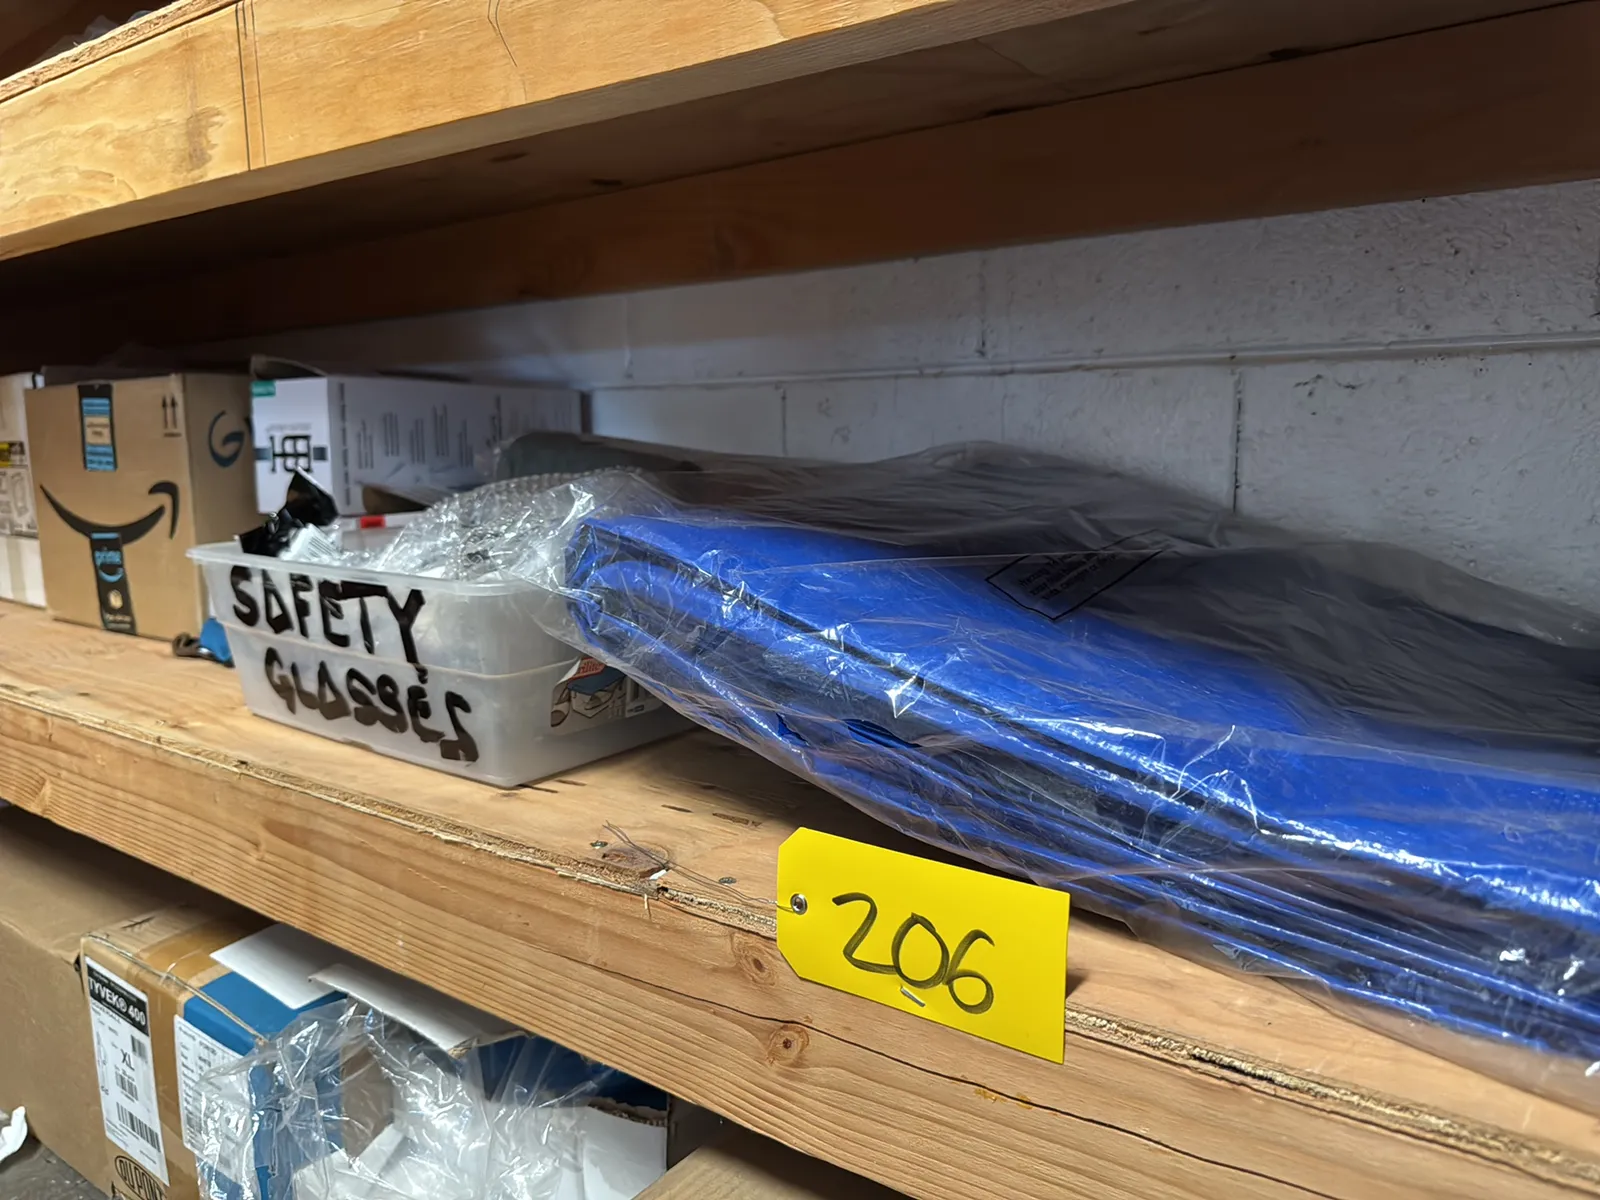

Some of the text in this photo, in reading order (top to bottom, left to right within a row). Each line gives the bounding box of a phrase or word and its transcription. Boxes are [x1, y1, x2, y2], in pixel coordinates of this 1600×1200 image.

[229, 565, 425, 667] SAFETY
[264, 646, 479, 763] GLASSES
[831, 891, 996, 1015] 206
[120, 1047, 136, 1072] XL
[128, 1004, 146, 1026] 400
